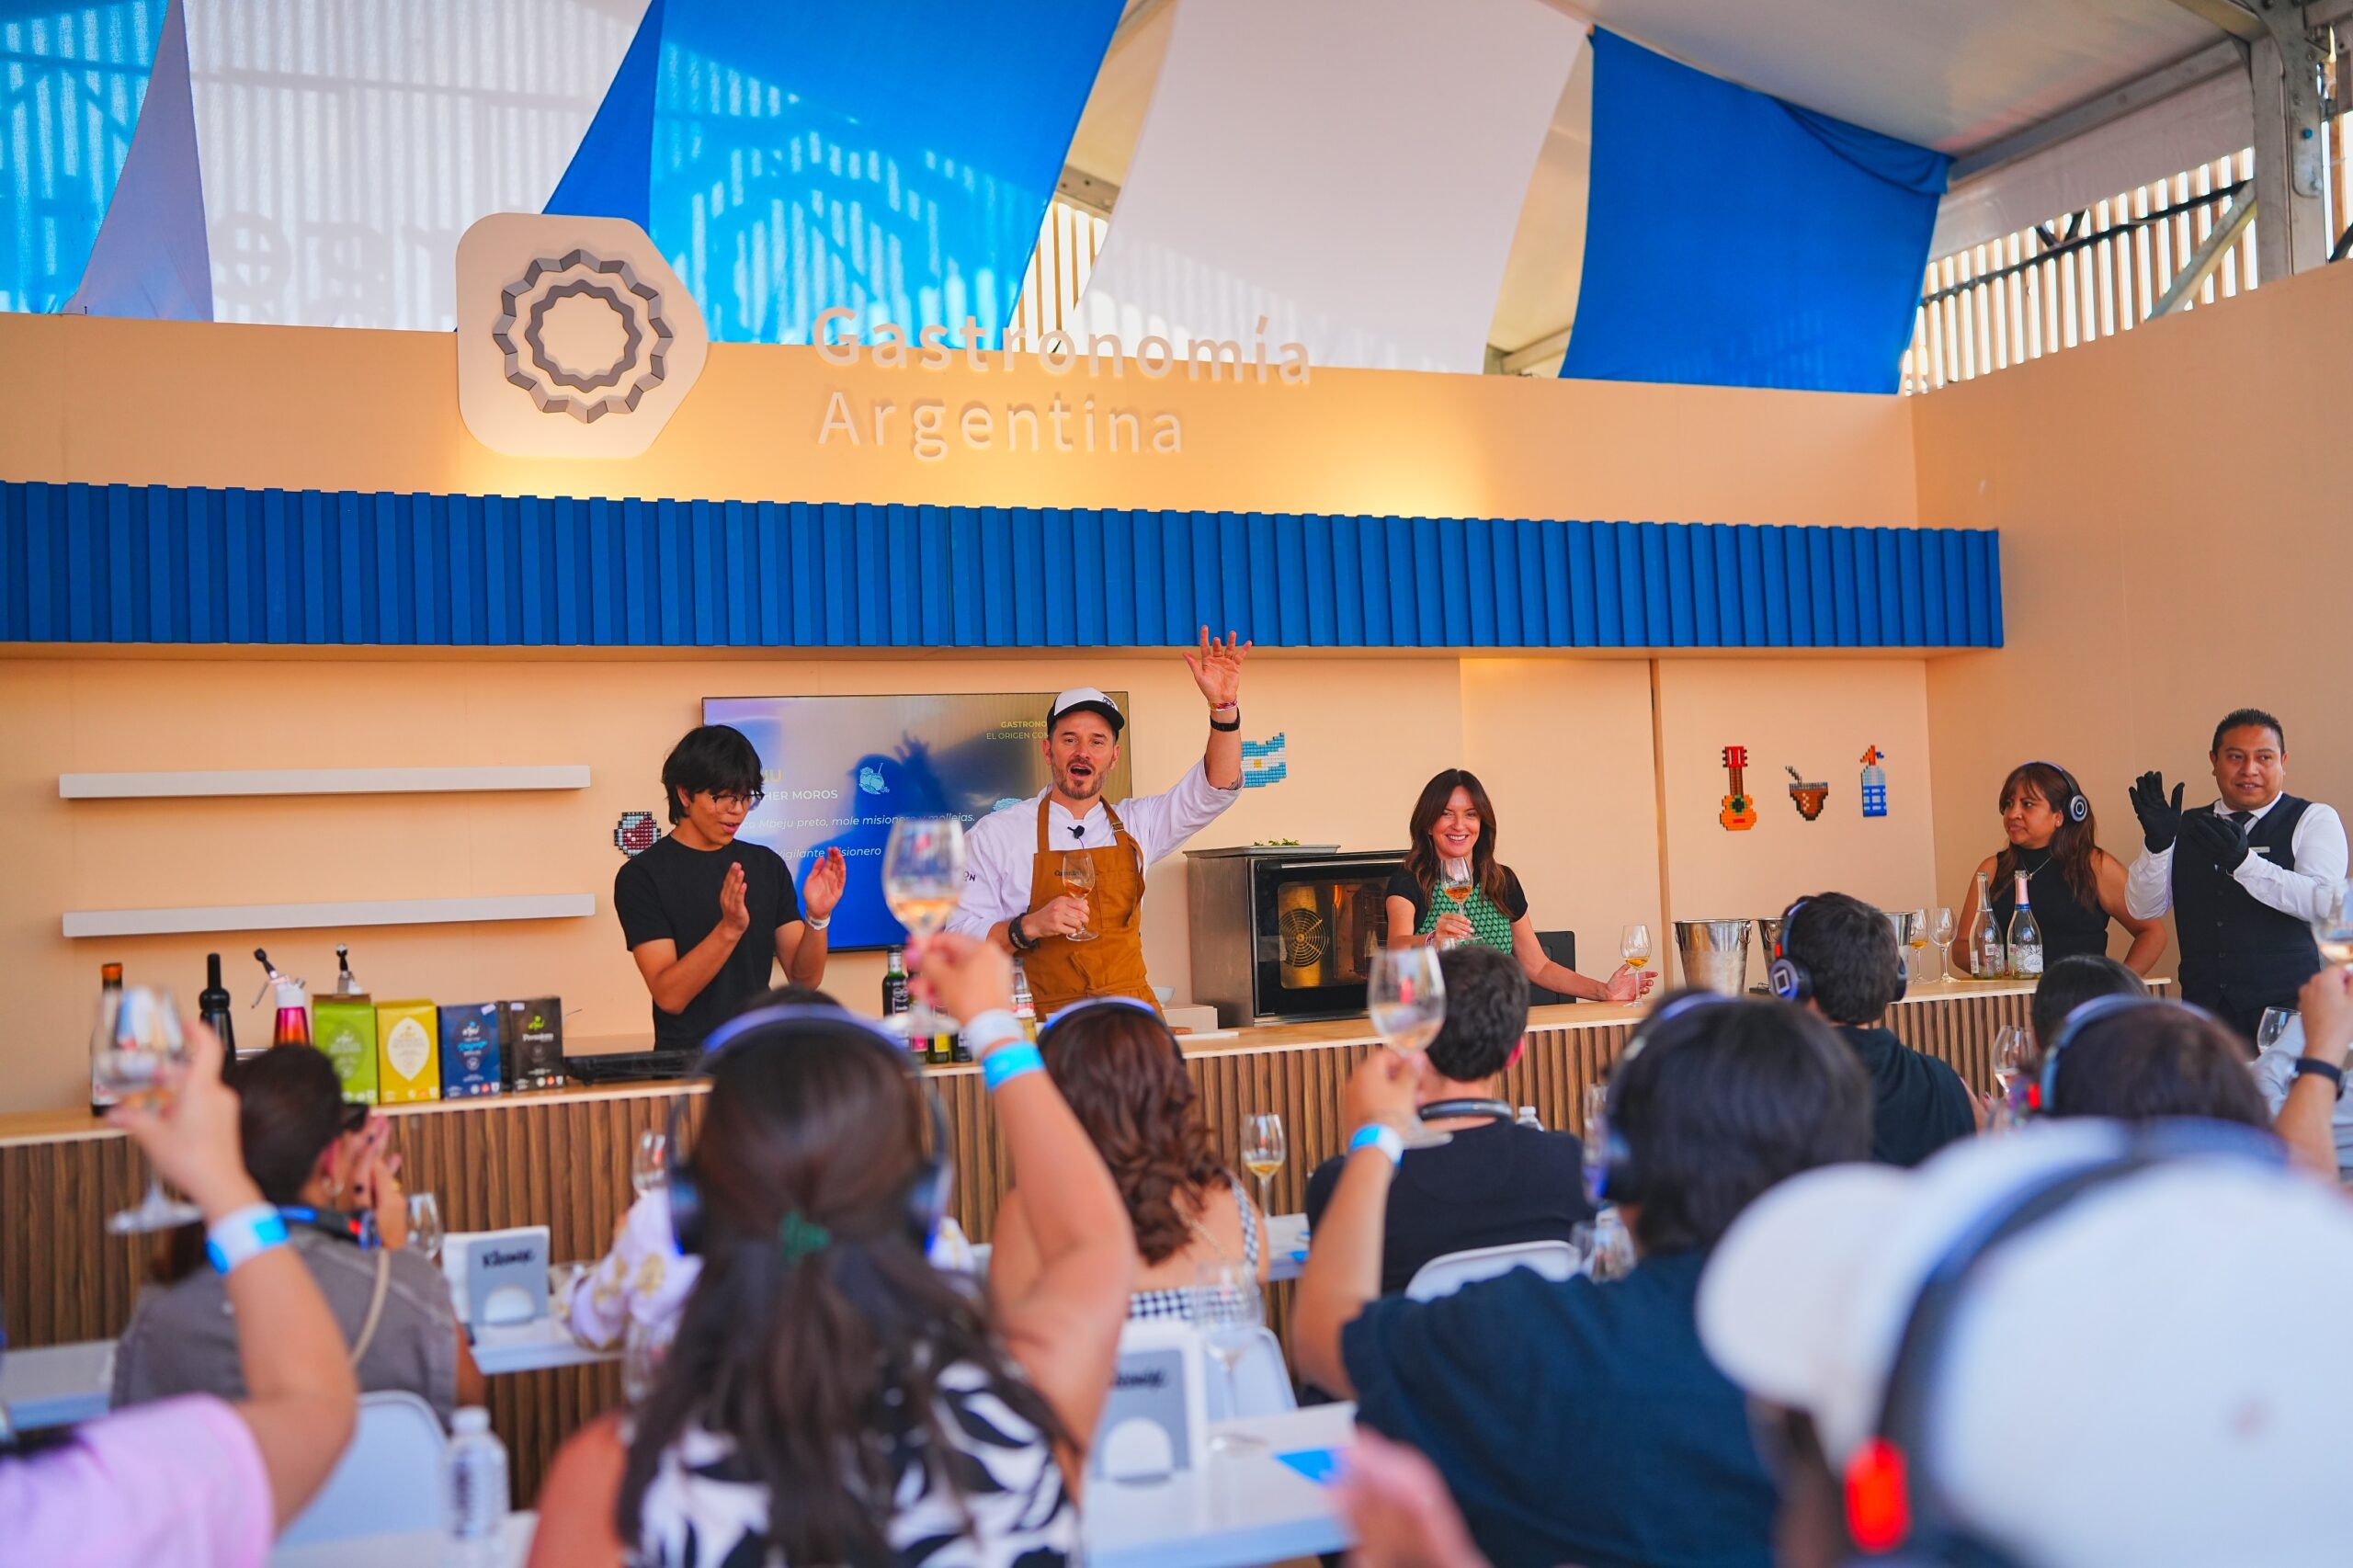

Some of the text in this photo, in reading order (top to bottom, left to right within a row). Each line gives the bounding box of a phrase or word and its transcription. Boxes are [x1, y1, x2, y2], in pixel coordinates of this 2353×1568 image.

[812, 306, 1312, 386] Gastronomía
[817, 390, 1183, 461] Argentina
[998, 732, 1030, 740] ORIGEN
[792, 790, 838, 801] MOROS
[796, 817, 829, 830] preto,
[831, 815, 860, 826] mole
[830, 846, 881, 858] isionero
